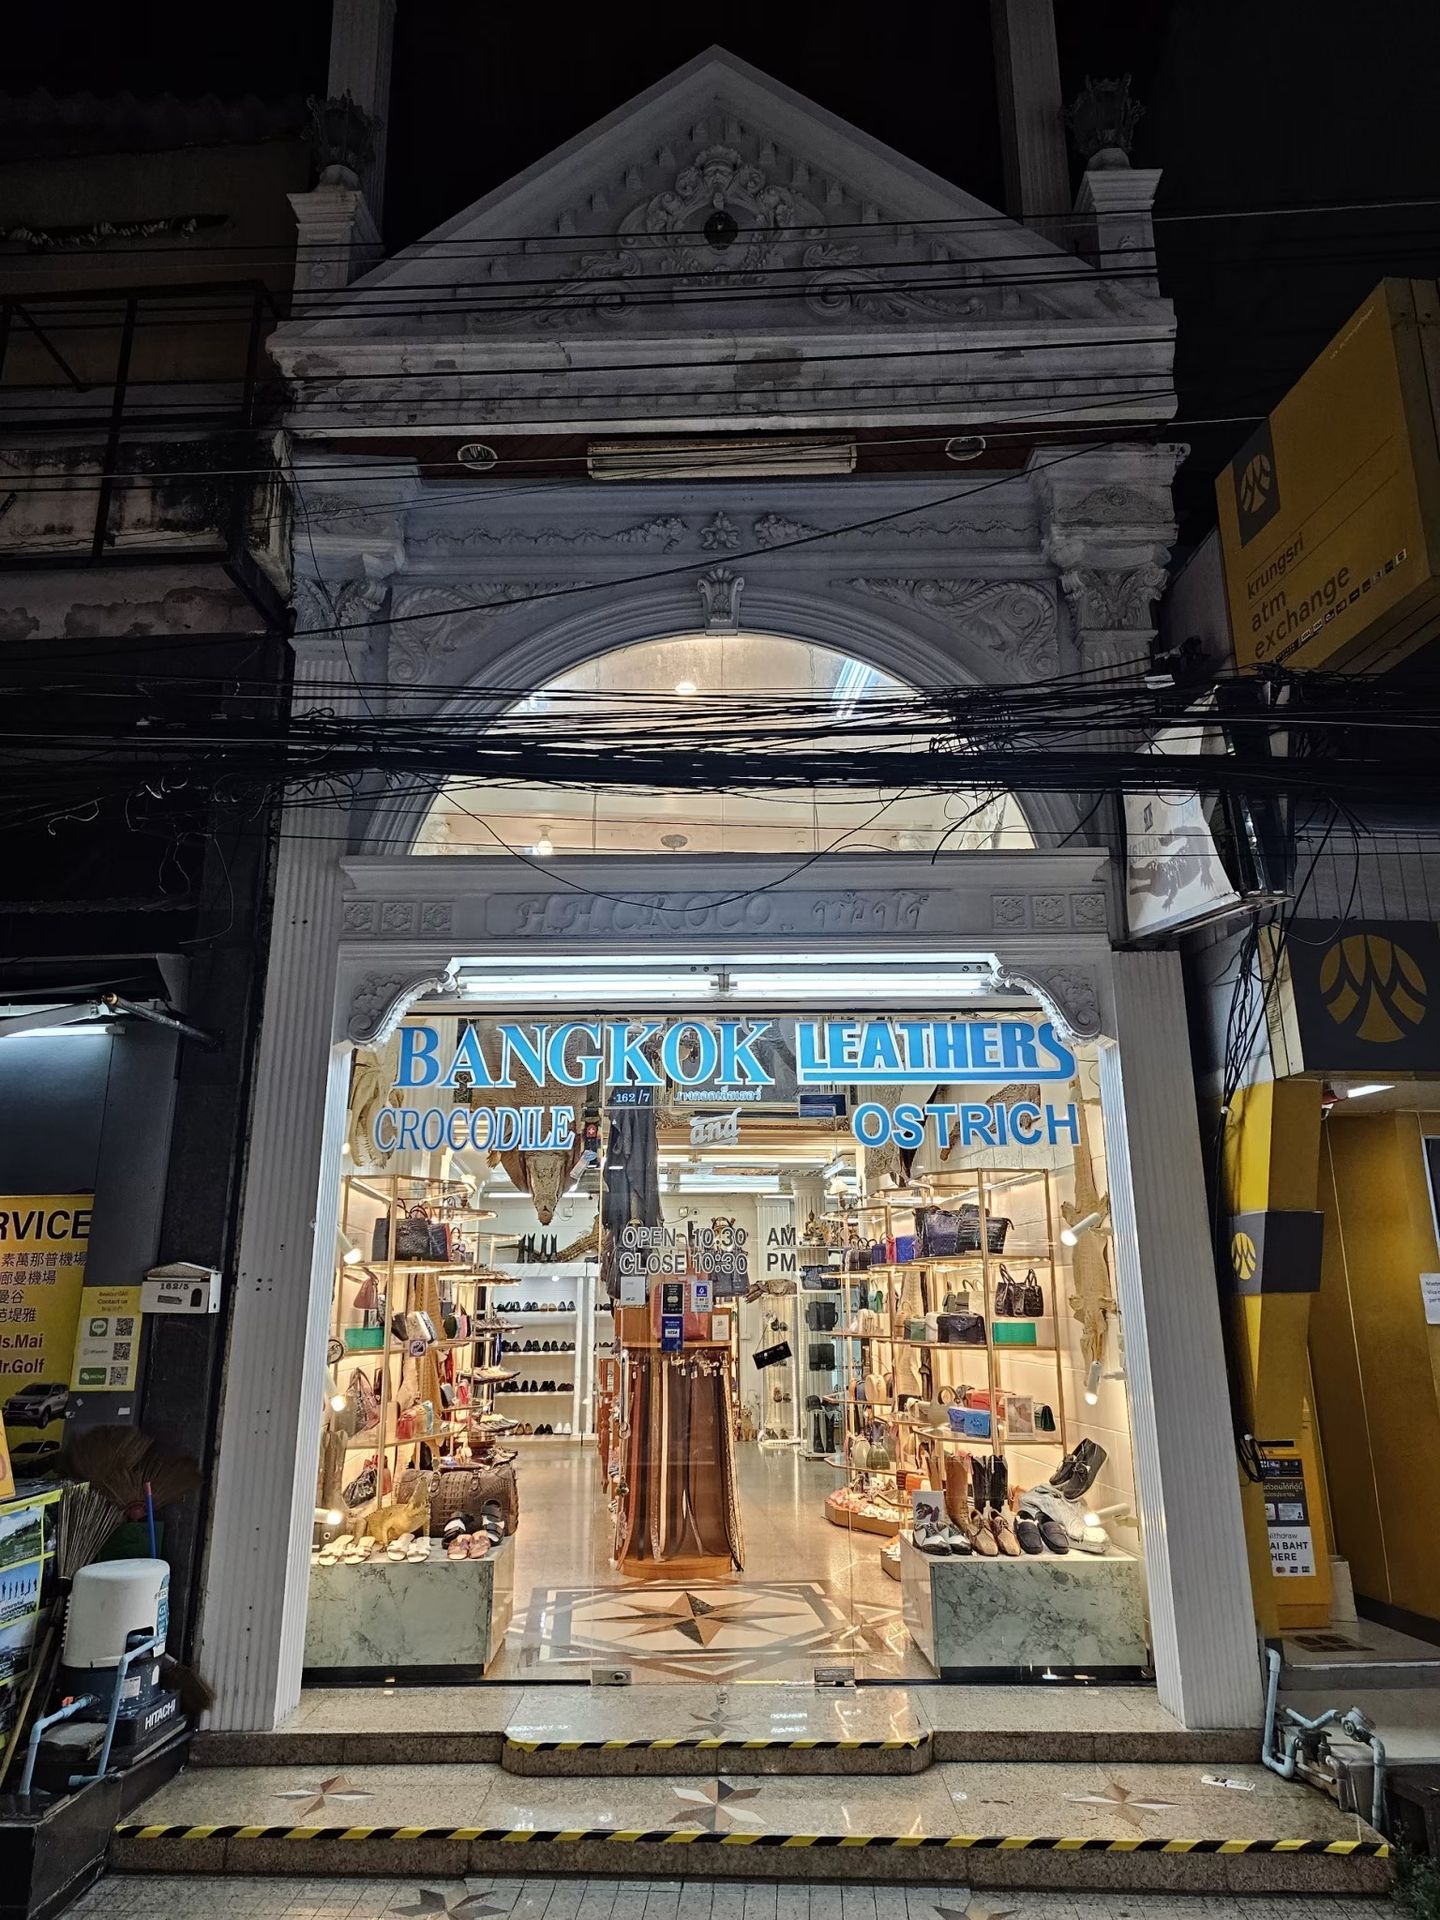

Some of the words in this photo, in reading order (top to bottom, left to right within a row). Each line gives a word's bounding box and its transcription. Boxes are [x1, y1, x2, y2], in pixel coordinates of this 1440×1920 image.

[1247, 531, 1304, 600] krungsri
[1251, 590, 1287, 633] atm
[1254, 566, 1351, 660] exchange
[393, 1020, 775, 1088] BANGKOK
[795, 1020, 1077, 1085] LEATHERS
[613, 1089, 651, 1105] 162/7
[373, 1105, 576, 1151] CROCODILE
[689, 1107, 742, 1147] and
[852, 1102, 1081, 1149] OSTRICH
[622, 1226, 677, 1249] OPEN
[767, 1227, 803, 1247] AM.
[619, 1252, 687, 1275] CLOSE
[692, 1252, 749, 1275] 10:30
[767, 1253, 803, 1273] PM.
[0, 1332, 44, 1349] s.Mai
[0, 1358, 45, 1374] r.Golf
[1271, 1552, 1298, 1561] HERE
[1281, 1541, 1308, 1550] BAHT
[145, 1700, 177, 1730] HITACHI
